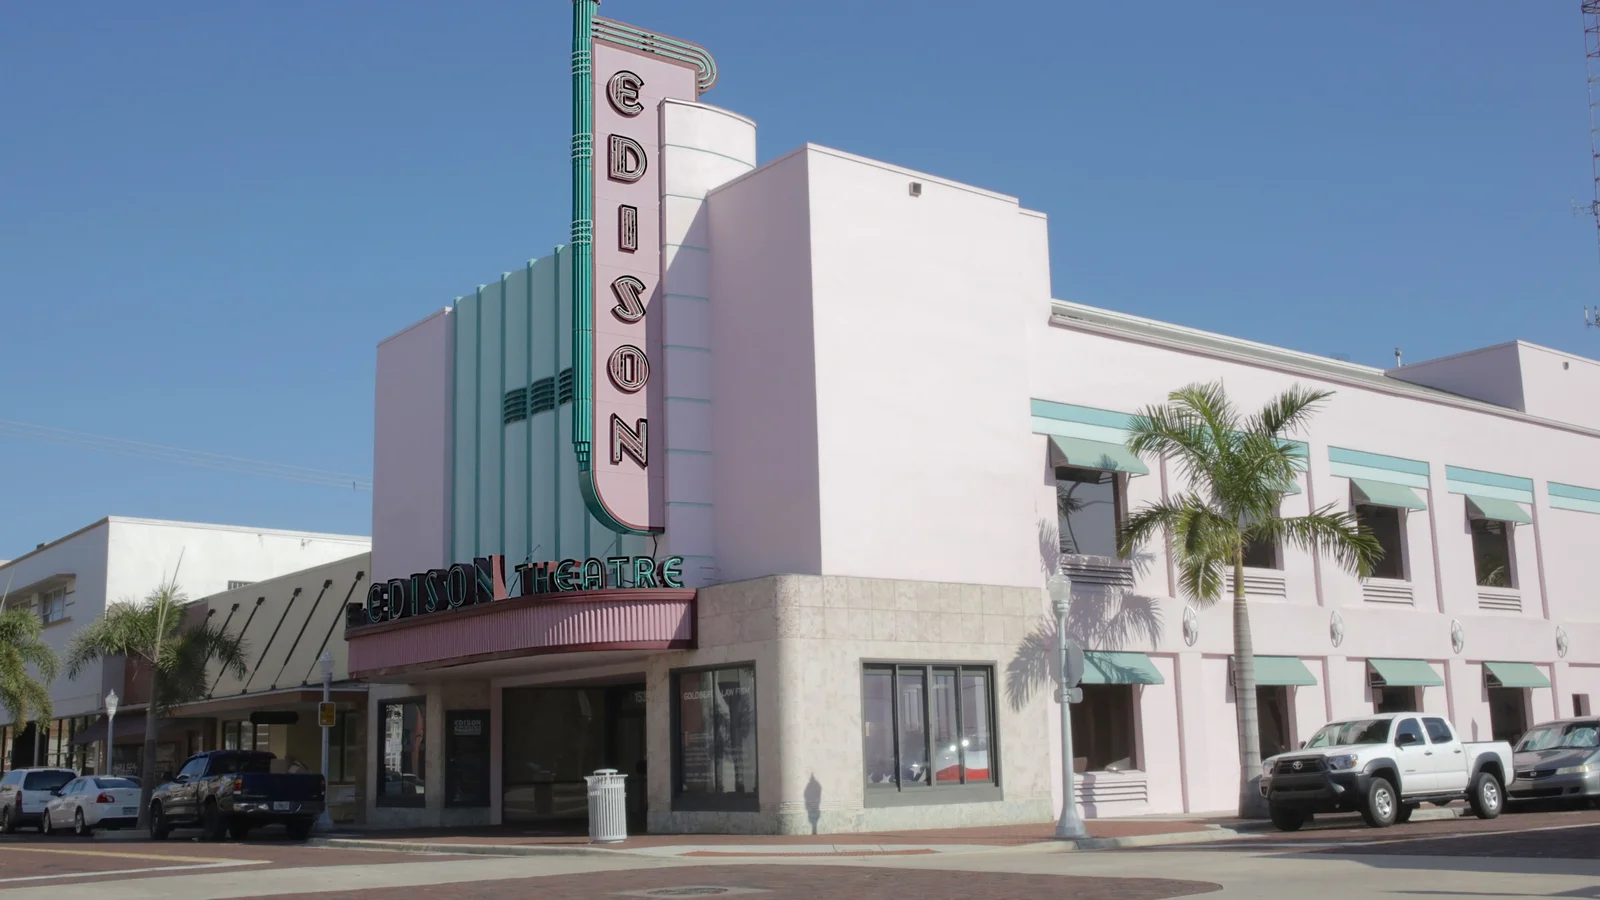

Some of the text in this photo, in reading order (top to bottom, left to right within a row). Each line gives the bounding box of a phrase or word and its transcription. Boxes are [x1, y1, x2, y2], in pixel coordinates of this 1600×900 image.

[606, 70, 650, 469] EDISON
[367, 554, 507, 623] EDISON
[516, 556, 685, 596] THEATRE
[721, 688, 734, 697] LAW
